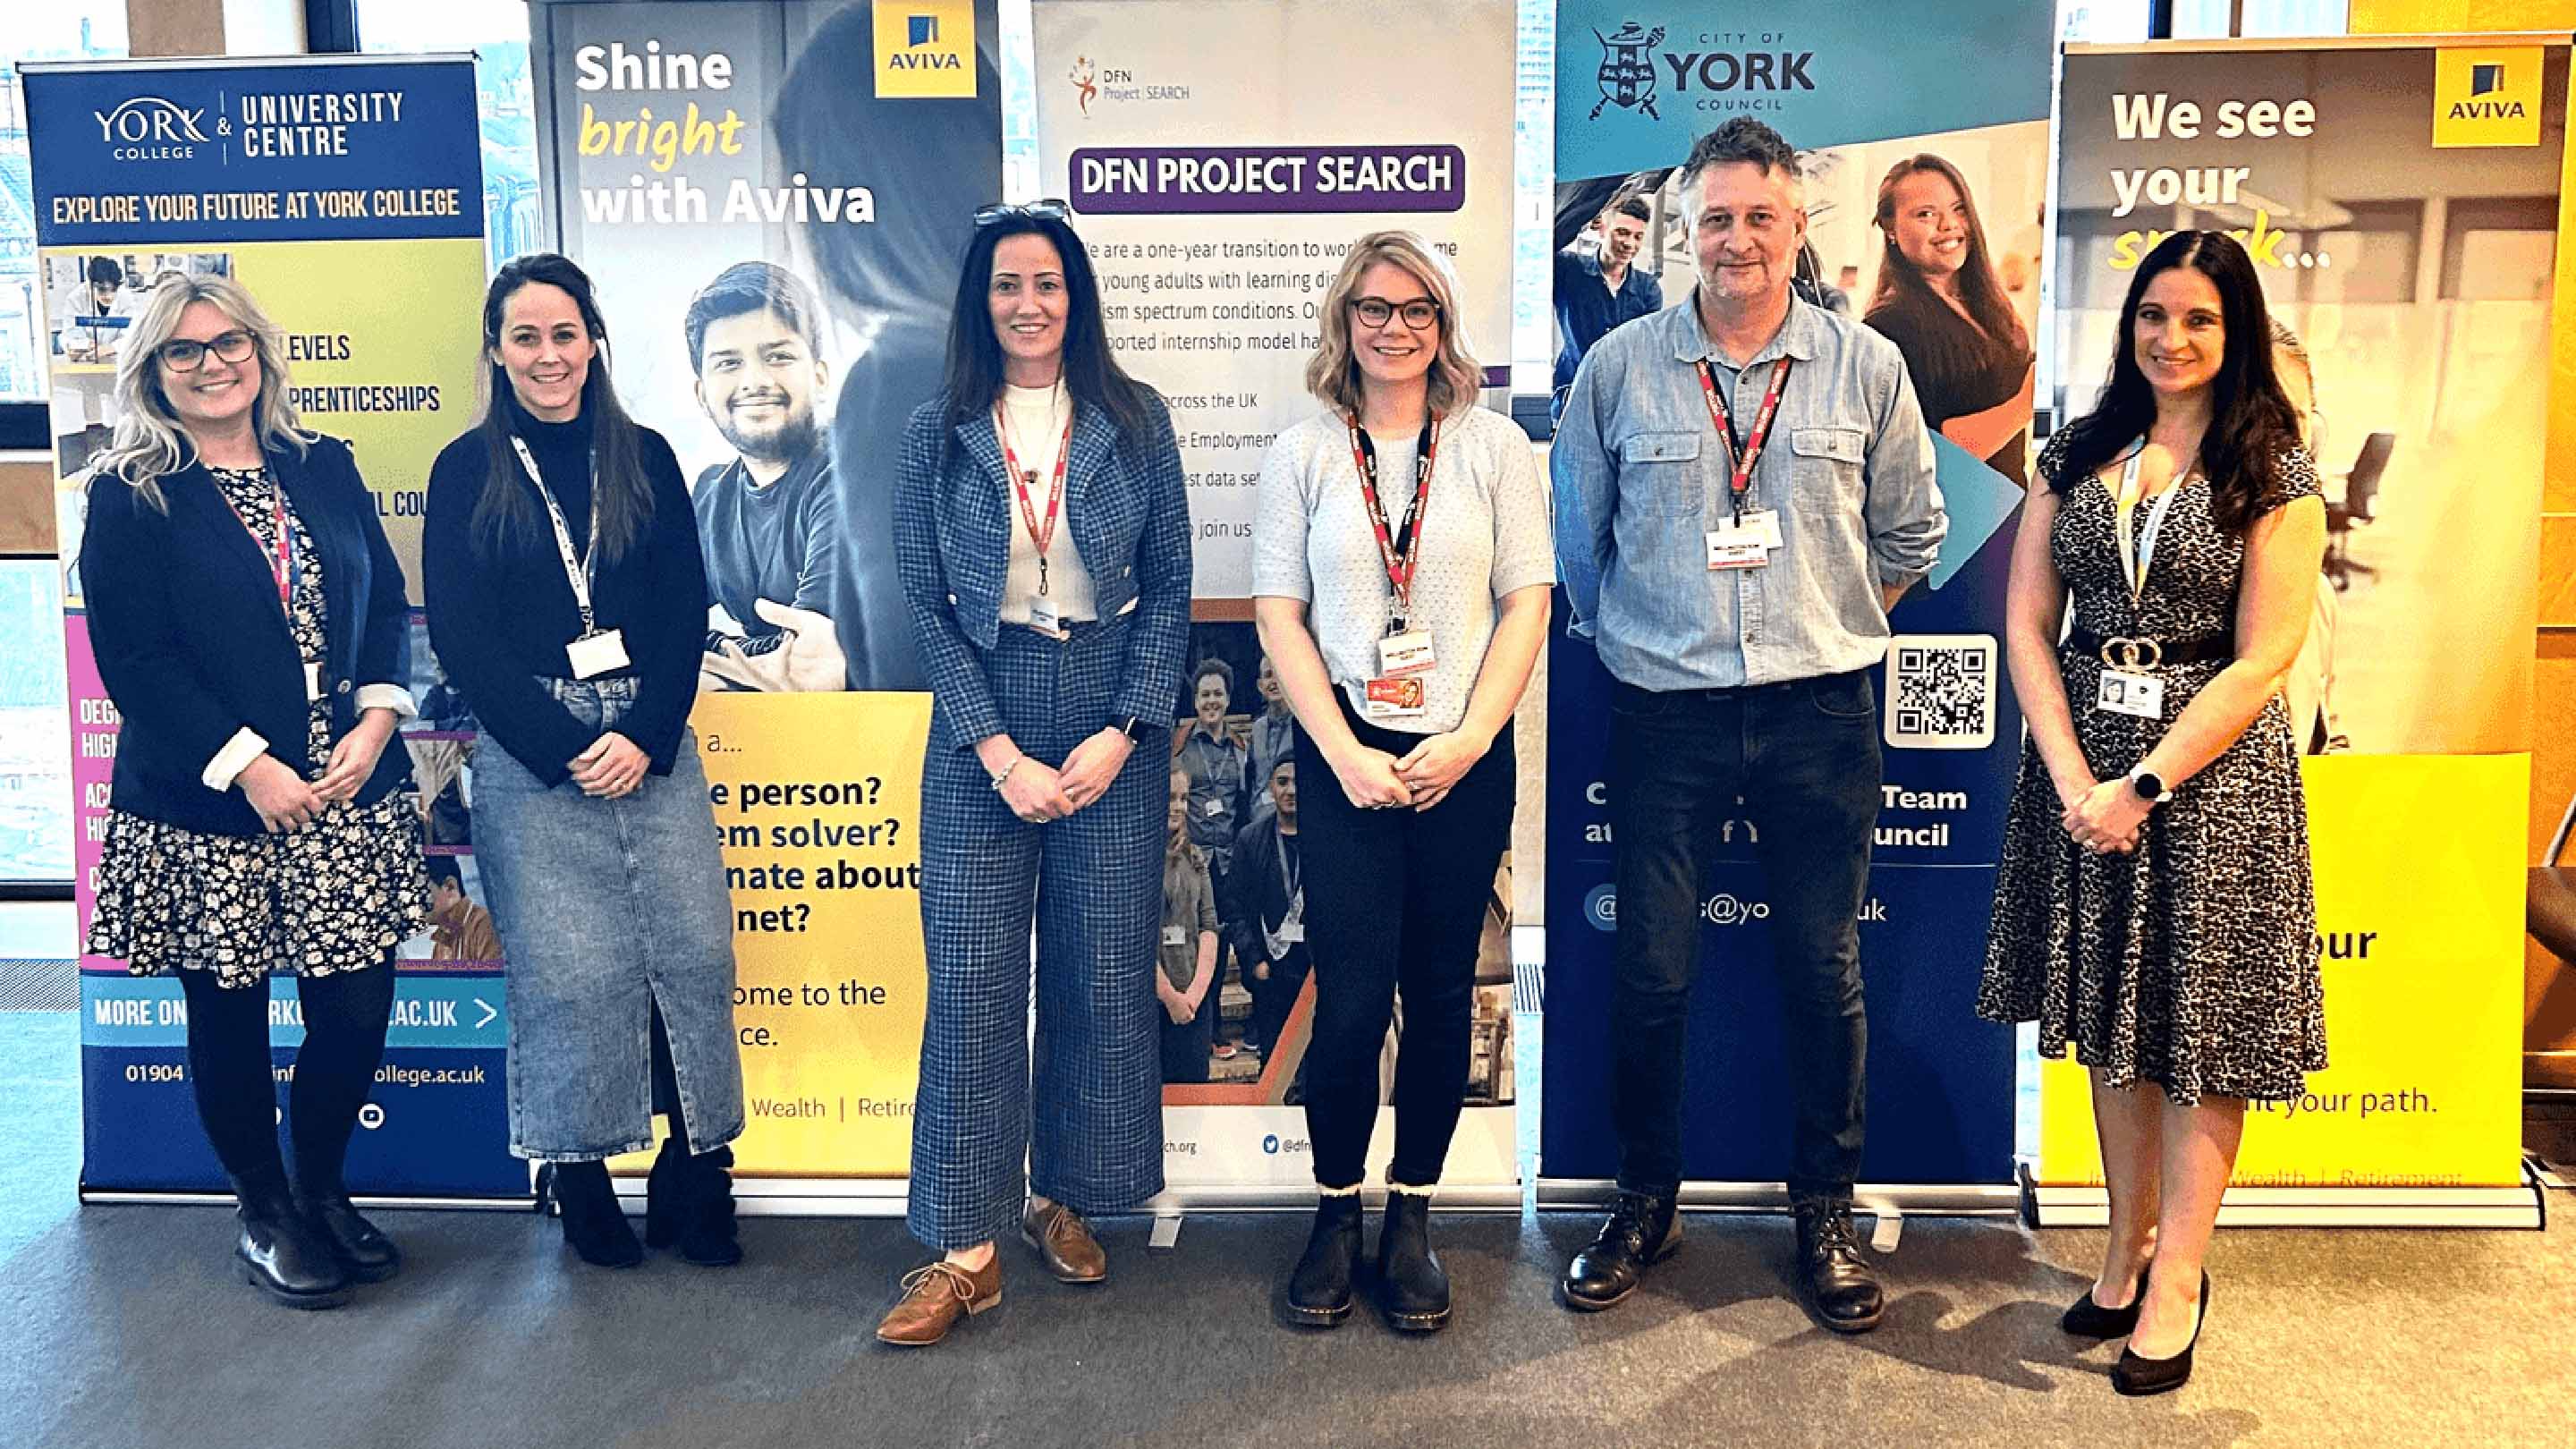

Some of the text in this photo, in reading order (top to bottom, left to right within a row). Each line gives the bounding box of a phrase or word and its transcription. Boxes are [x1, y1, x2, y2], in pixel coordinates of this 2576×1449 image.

[1699, 33, 1784, 43] CITY OF
[575, 38, 733, 90] Shine
[888, 53, 962, 71] AVIVA
[1664, 52, 1816, 92] YORK
[1104, 71, 1132, 83] DFN
[1104, 86, 1191, 102] Project SEARCH
[1696, 99, 1783, 111] COUNCIL
[95, 98, 209, 142] YORK
[242, 92, 403, 124] UNIVERSITY
[2112, 93, 2316, 140] We see
[2448, 101, 2526, 120] AVIVA
[217, 118, 232, 136] &
[579, 102, 745, 173] bright
[114, 147, 193, 159] COLLEGE
[243, 127, 349, 158] CENTRE
[1081, 155, 1453, 194] DFN PROJECT SEARCH
[580, 172, 876, 224] with Aviva
[2110, 166, 2250, 217] your
[53, 188, 461, 225] EXPLORE YOUR FUTURE AT YORK COLLEGE
[1104, 243, 1128, 258] are
[1133, 243, 1143, 258] a
[1148, 242, 1218, 262] one-year
[1223, 239, 1299, 258] transition
[1303, 241, 1319, 257] to
[1102, 274, 1149, 292] young
[1154, 271, 1204, 290] adults
[1208, 271, 1241, 289] with
[1246, 270, 1311, 292] learning
[1134, 302, 1207, 323] spectrum
[1212, 301, 1297, 319] conditions.
[286, 335, 351, 360] EVELS
[1162, 332, 1241, 355] internship
[1248, 332, 1295, 350] model
[1212, 394, 1234, 408] the
[1239, 394, 1259, 408] UK
[1206, 471, 1236, 487] data
[1199, 519, 1228, 540] join
[740, 776, 882, 813] person?
[1882, 785, 1967, 809] Team
[771, 818, 901, 847] solver?
[816, 860, 920, 890] about
[801, 983, 830, 1006] to
[839, 979, 886, 1005] the
[95, 999, 153, 1025] MORE
[125, 1064, 183, 1082] 01904
[751, 1097, 826, 1118] Wealth
[2285, 1093, 2352, 1119] your
[2361, 1088, 2437, 1119] path.
